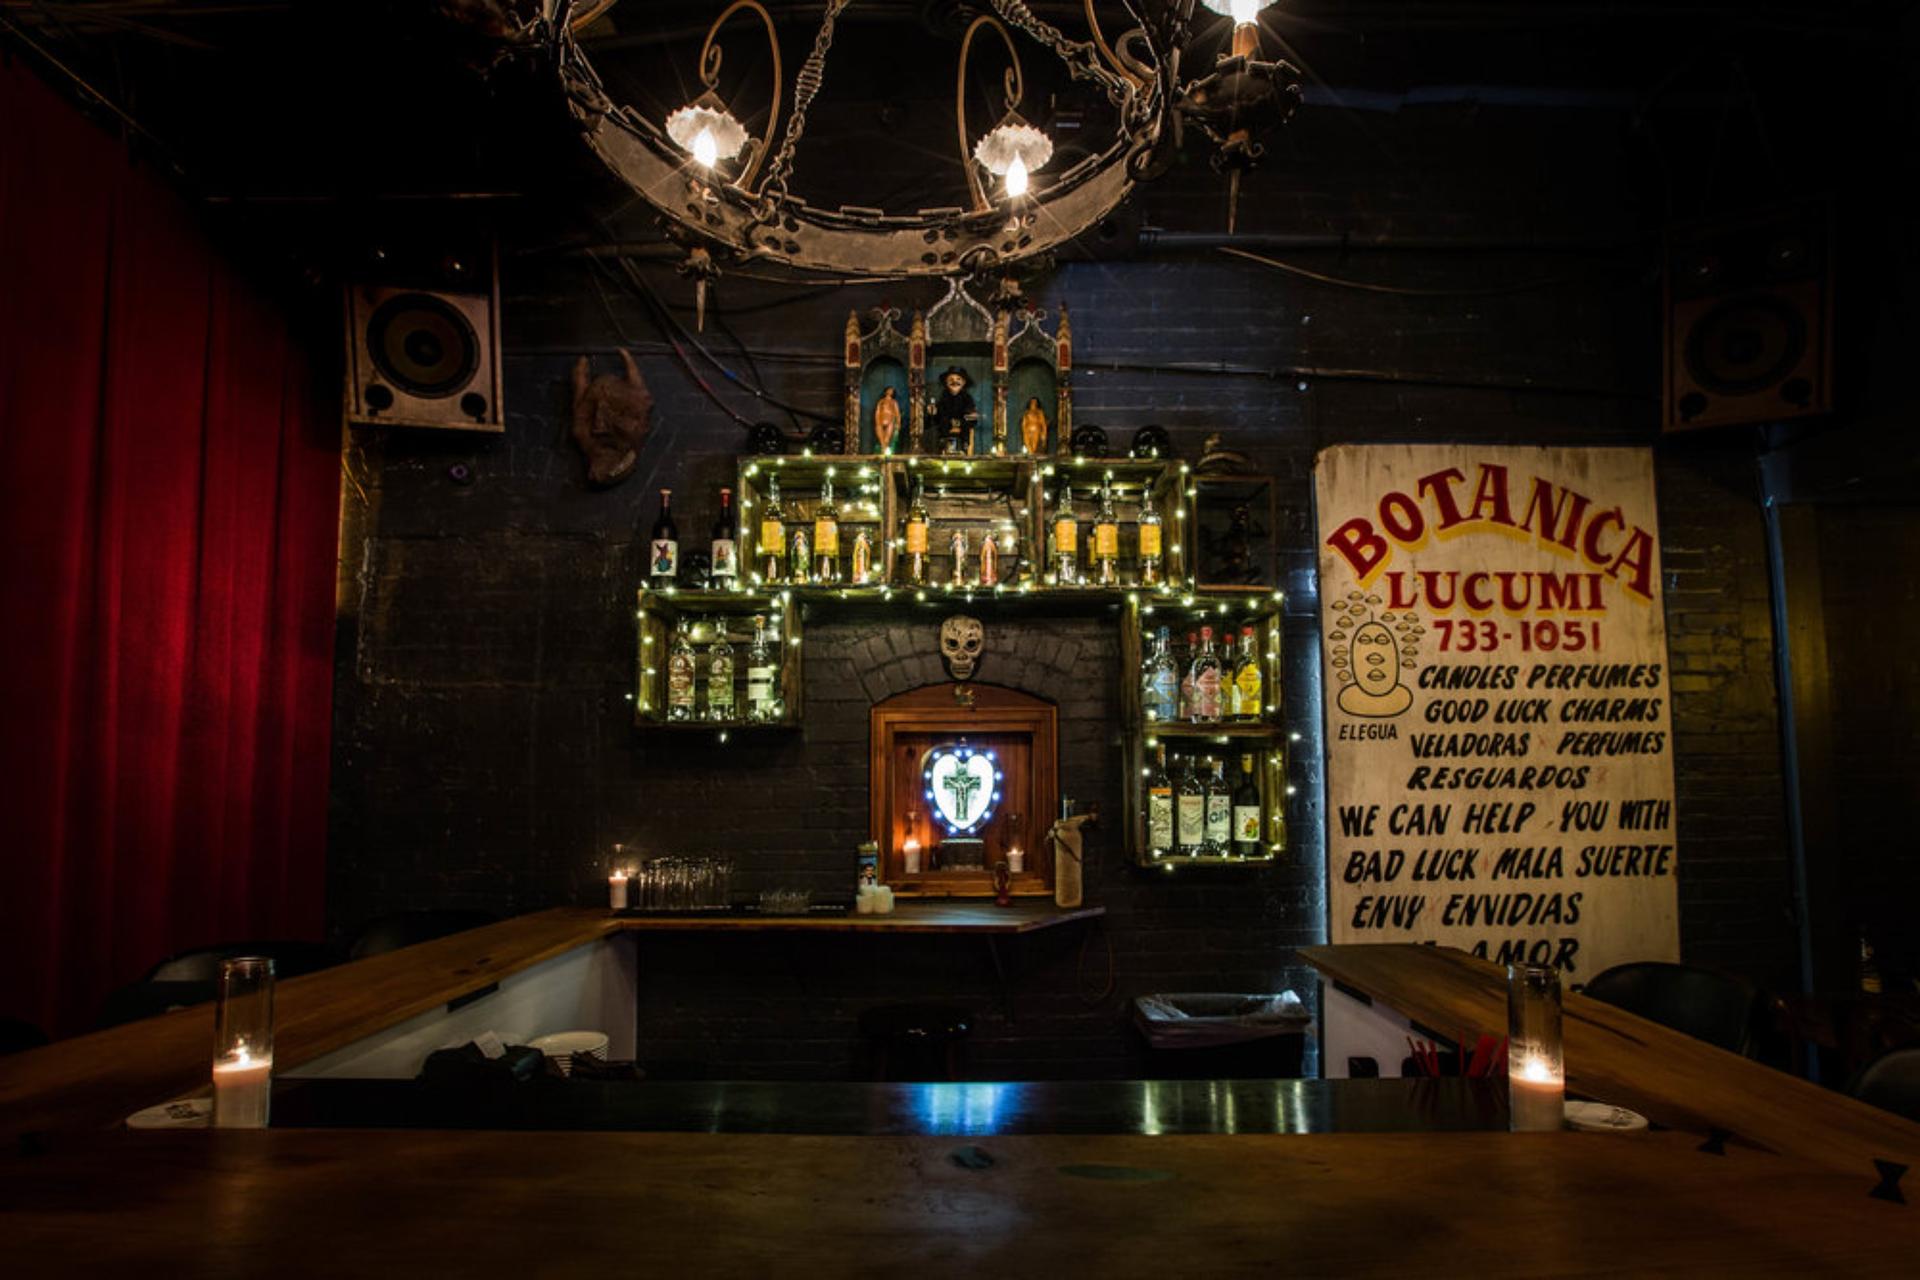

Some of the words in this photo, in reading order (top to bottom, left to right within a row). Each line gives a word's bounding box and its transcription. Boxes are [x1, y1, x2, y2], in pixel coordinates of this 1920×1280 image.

[1326, 463, 1654, 600] BOTANICA
[1384, 571, 1607, 611] LUCUMI
[1433, 620, 1600, 652] 733-1051
[1418, 665, 1518, 690] CANDLES
[1526, 664, 1661, 689] PERFUMES
[1425, 699, 1489, 724] GOOD
[1494, 699, 1549, 724] LUCK
[1560, 699, 1661, 723] CHARMS
[1338, 723, 1398, 741] ELEGUA
[1411, 733, 1530, 758] VELADORAS
[1556, 731, 1665, 757] PERFUMES
[1407, 765, 1590, 790] RESGUARDOS
[1339, 805, 1380, 837] WE
[1389, 804, 1451, 836] CAN
[1462, 802, 1535, 834] HELP
[1559, 801, 1609, 833] YOU
[1619, 799, 1671, 831] WITH
[1344, 850, 1404, 883] BAD
[1411, 849, 1479, 882] LUCK
[1492, 847, 1563, 880] MALA
[1575, 844, 1673, 877] SUERTE
[1351, 895, 1425, 930] ENVY
[1441, 892, 1582, 926] ENVIDIAS
[1472, 938, 1578, 972] AMOR
